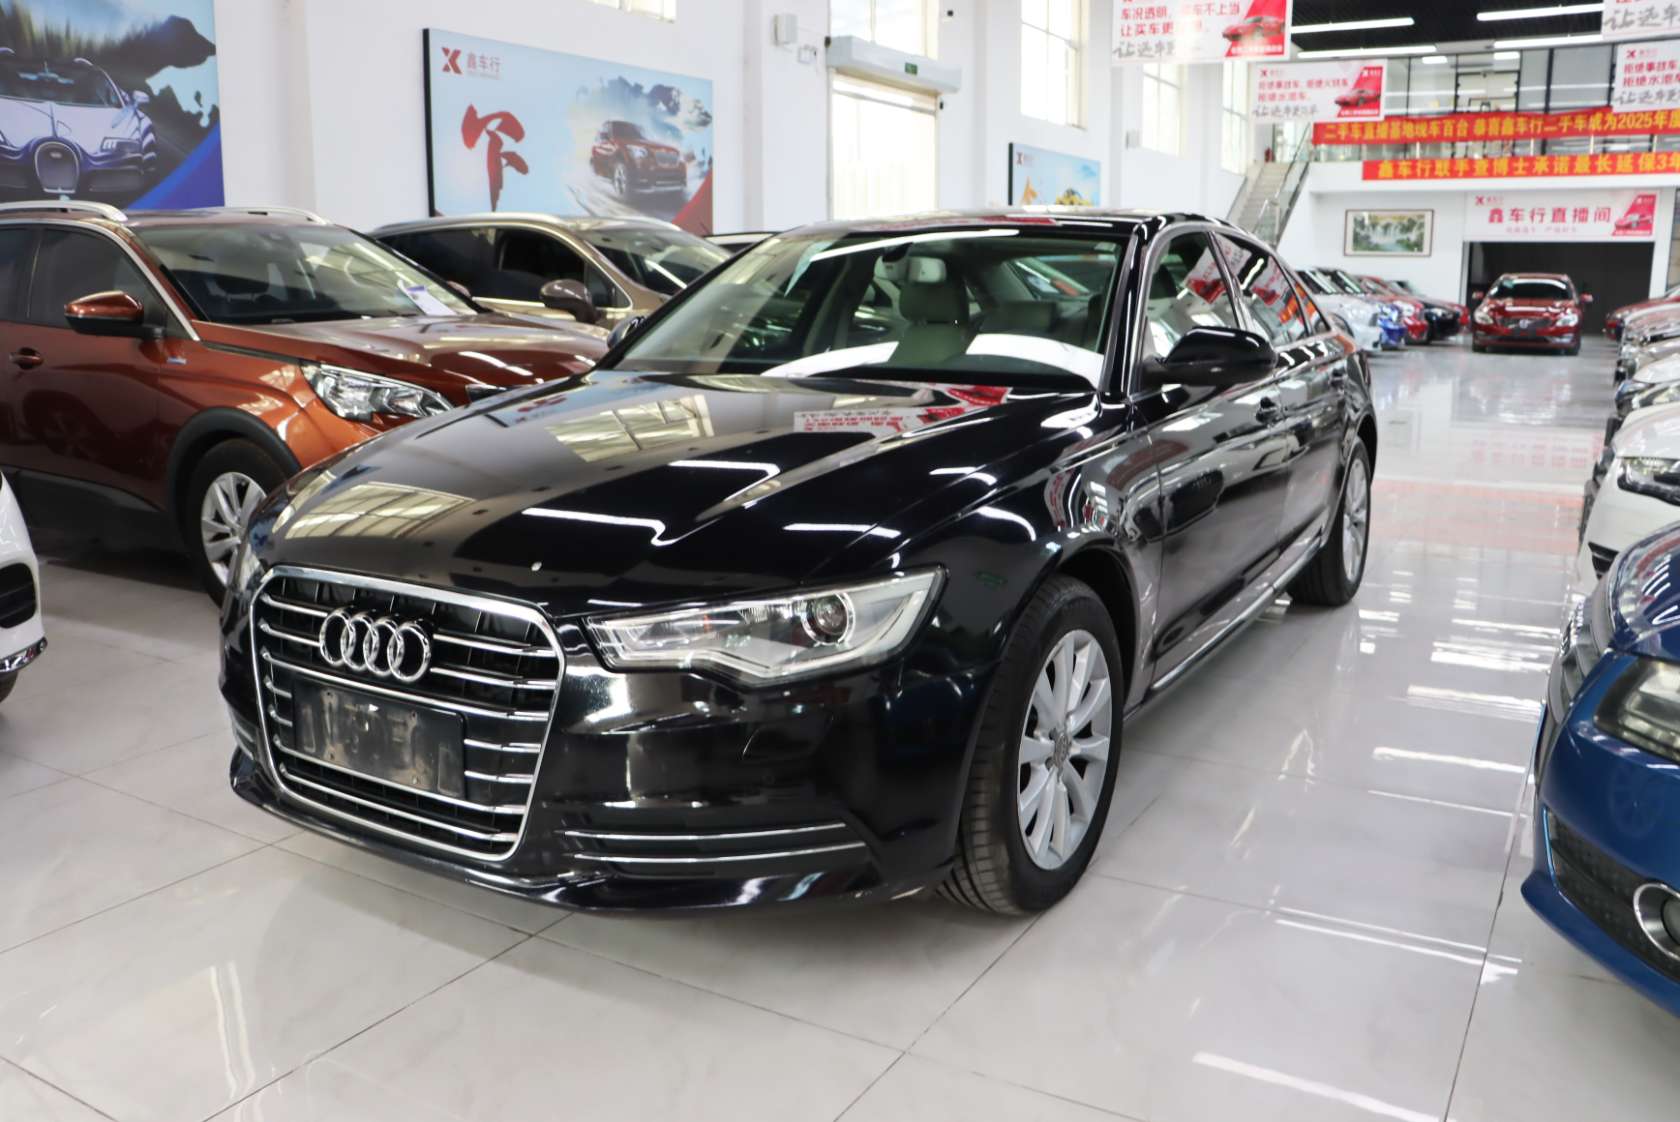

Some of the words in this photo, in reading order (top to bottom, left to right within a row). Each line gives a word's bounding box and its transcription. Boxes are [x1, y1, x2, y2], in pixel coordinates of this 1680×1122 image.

[467, 51, 502, 72] 鑫车行
[1488, 206, 1612, 224] 鑫车行直播间
